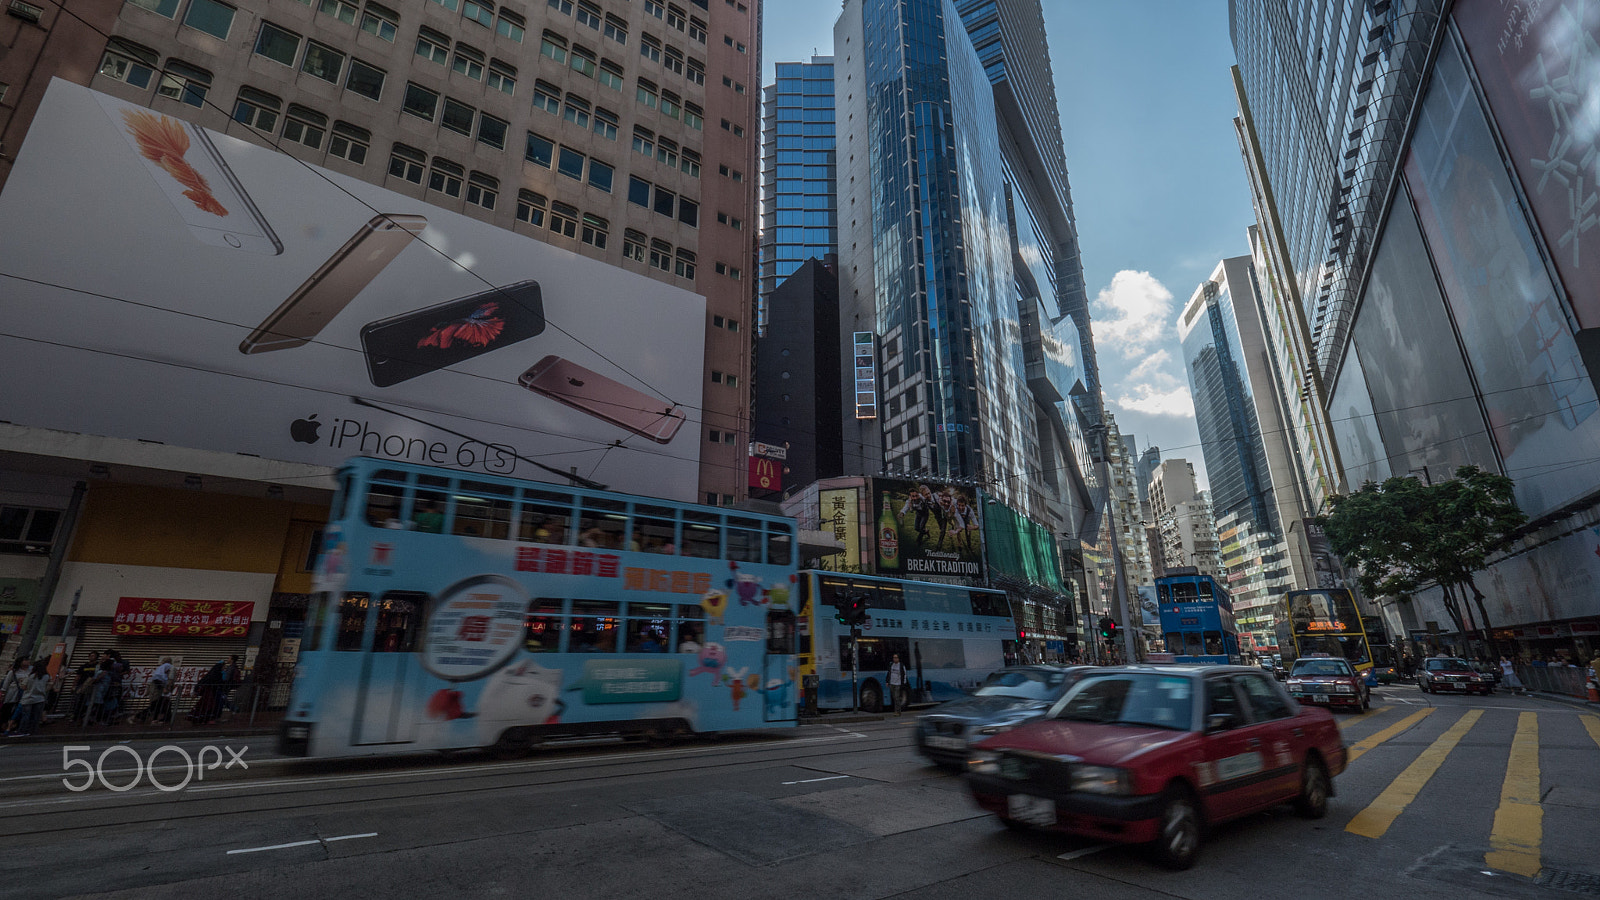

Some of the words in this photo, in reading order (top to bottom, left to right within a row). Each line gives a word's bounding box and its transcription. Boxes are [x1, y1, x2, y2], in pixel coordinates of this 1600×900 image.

[329, 418, 448, 464] iPhone
[907, 558, 936, 572] BREAK
[936, 559, 979, 575] TRADITION
[116, 623, 180, 635] 9387
[187, 624, 246, 636] 9279
